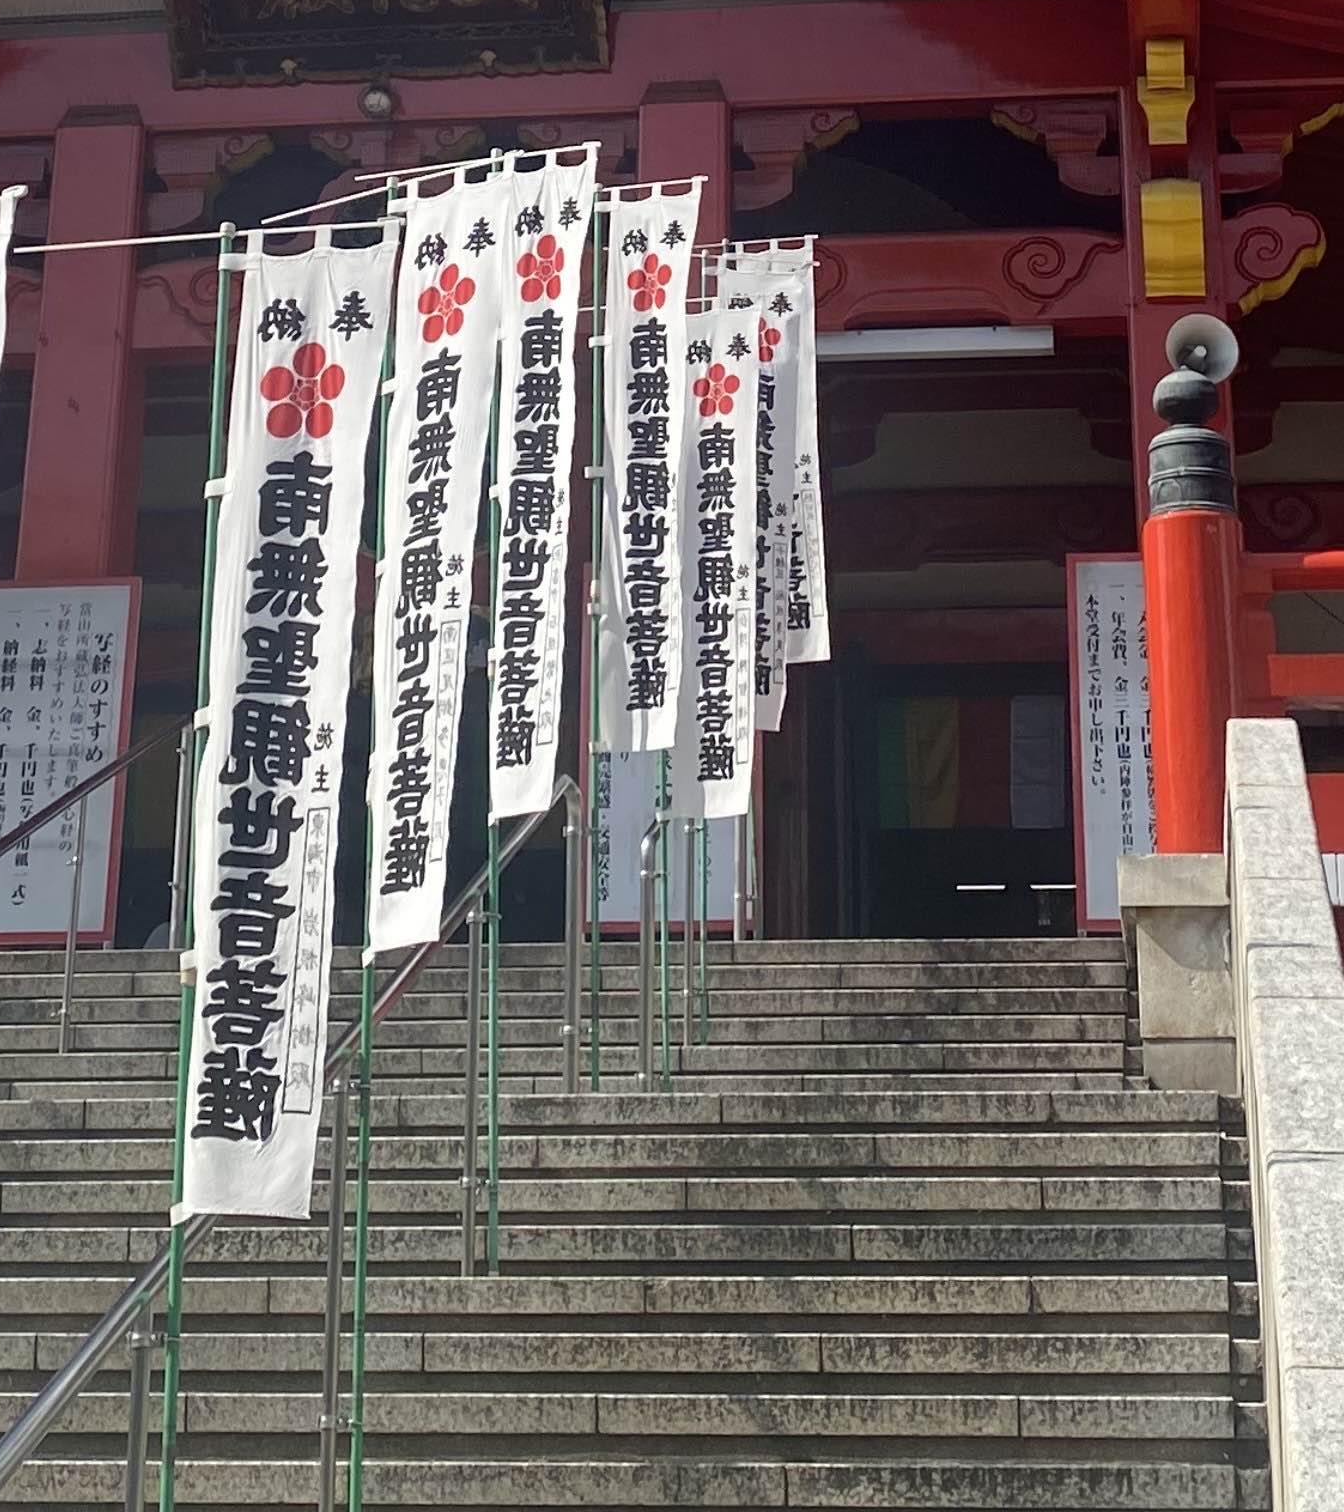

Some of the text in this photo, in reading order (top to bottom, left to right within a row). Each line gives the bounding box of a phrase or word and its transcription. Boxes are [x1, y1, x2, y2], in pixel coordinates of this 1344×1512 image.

[85, 632, 114, 763] 写経のすすめ
